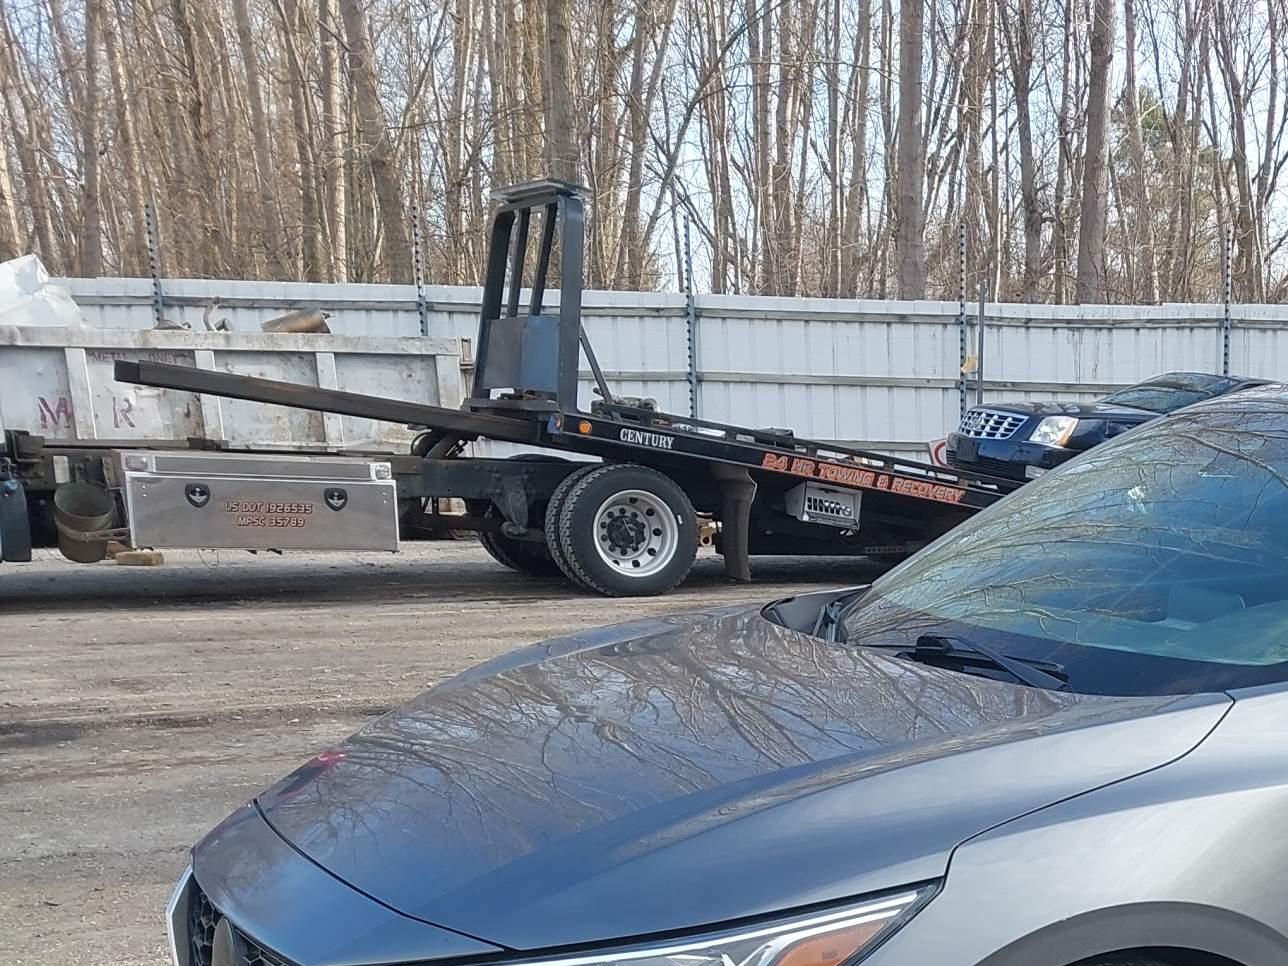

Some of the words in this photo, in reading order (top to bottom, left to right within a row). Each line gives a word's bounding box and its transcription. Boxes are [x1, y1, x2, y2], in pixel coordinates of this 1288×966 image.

[619, 427, 675, 449] CENTURY
[761, 452, 788, 471] 24
[791, 458, 815, 477] HR
[818, 463, 875, 487] TOWING
[892, 476, 966, 504] RECOVERY
[225, 501, 240, 513] US
[242, 502, 263, 513] DOT
[266, 503, 313, 514] 1926535
[238, 515, 266, 527] MPSC
[269, 516, 305, 527] 35789
